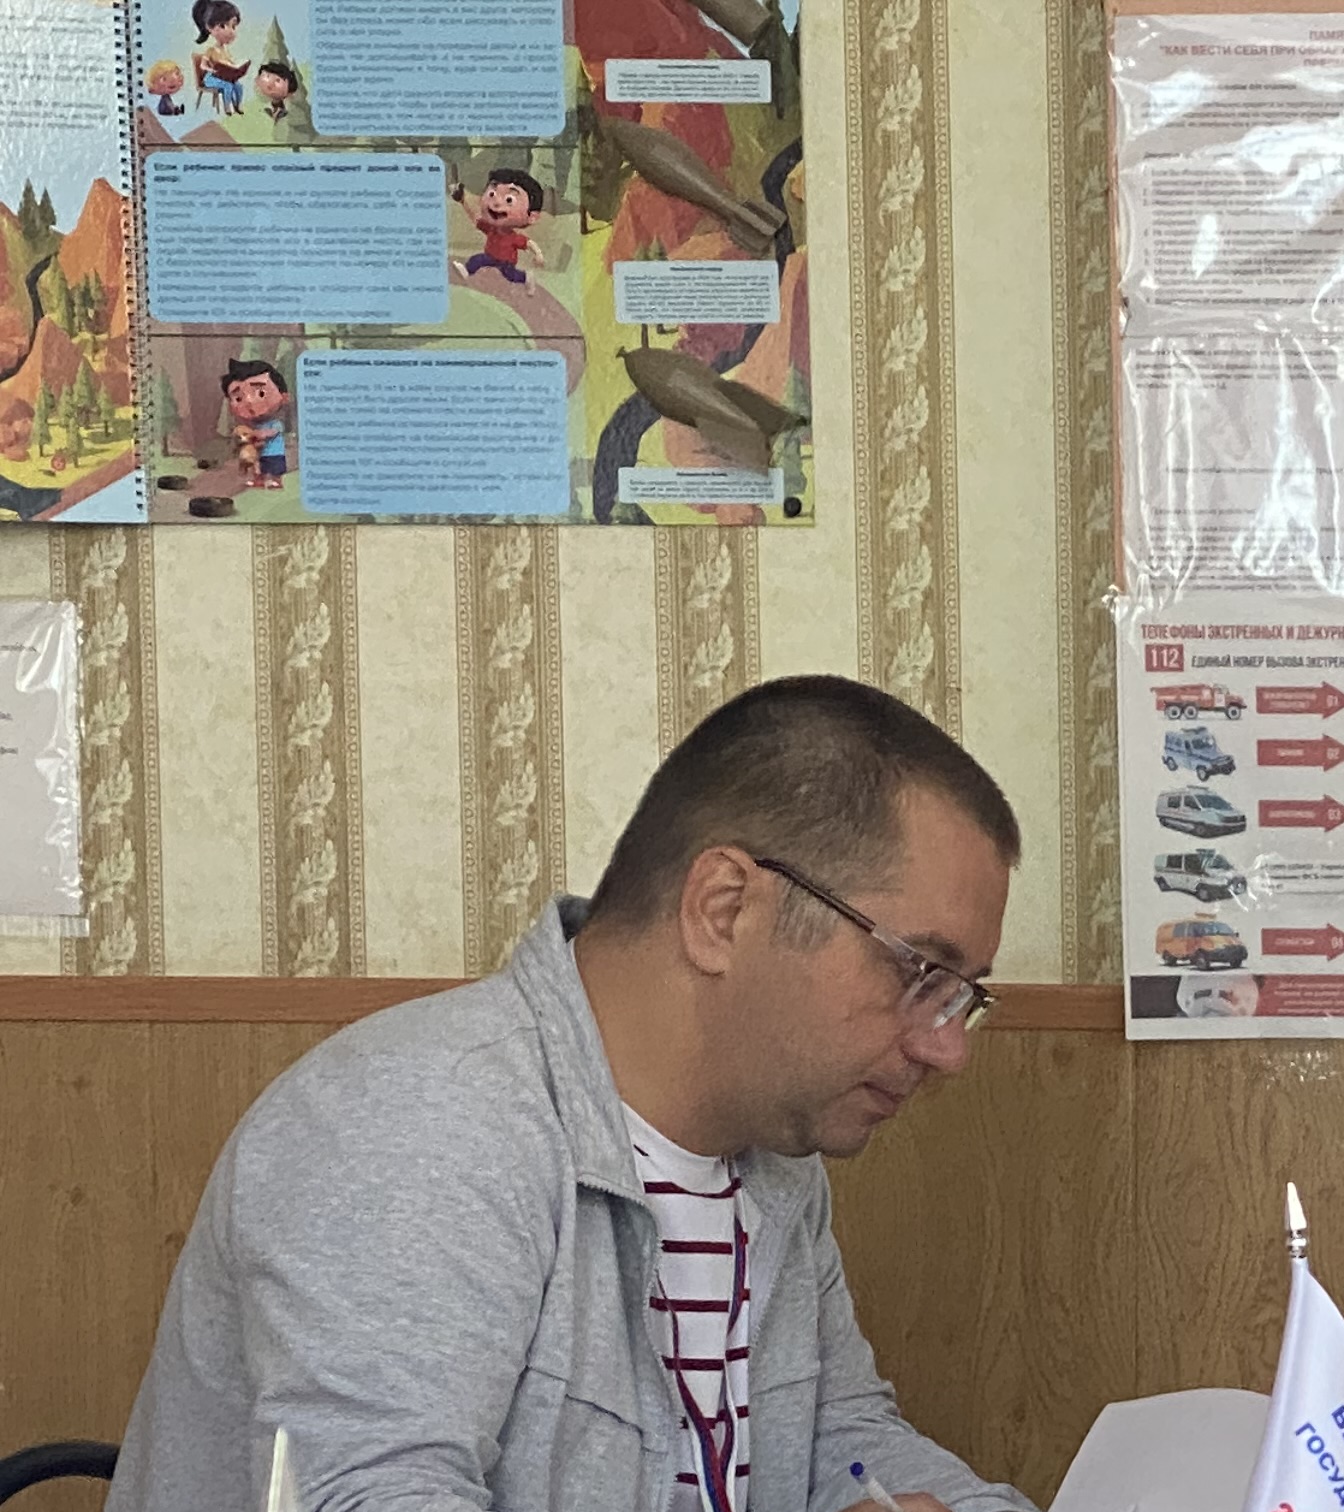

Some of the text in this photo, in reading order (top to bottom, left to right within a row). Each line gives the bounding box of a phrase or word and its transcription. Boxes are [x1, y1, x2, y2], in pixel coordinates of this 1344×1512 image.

[1191, 45, 1232, 56] ВЕСТИ
[1234, 45, 1268, 56] СЕБЯ
[1141, 624, 1205, 640] ТЕЛЕФОНЫ
[1207, 624, 1285, 640] ЭКСТРЕННЫХ
[1151, 648, 1180, 668] 112
